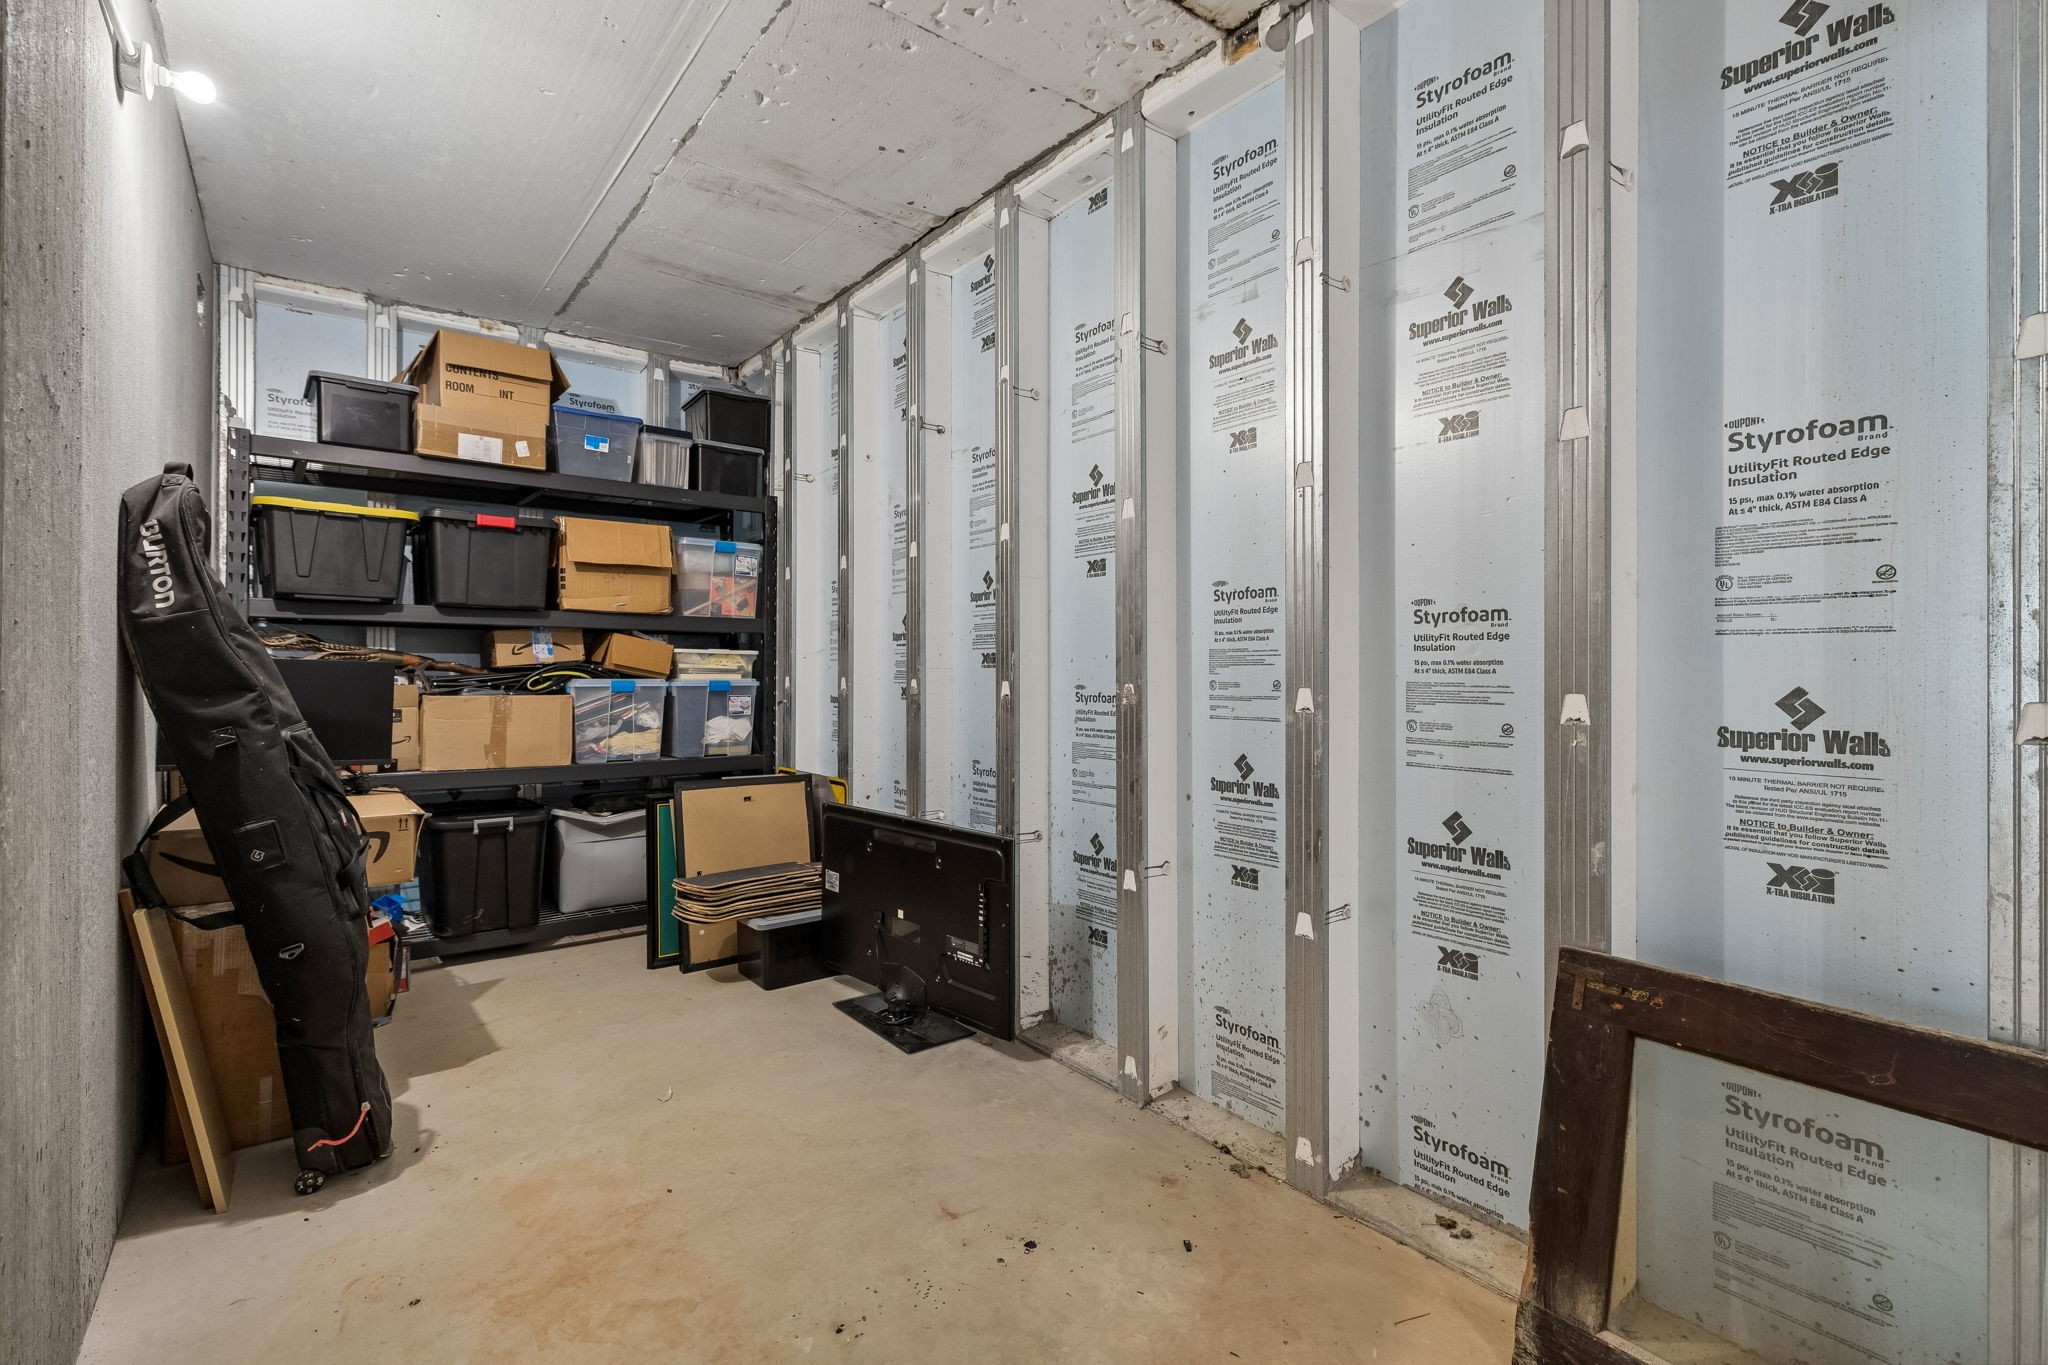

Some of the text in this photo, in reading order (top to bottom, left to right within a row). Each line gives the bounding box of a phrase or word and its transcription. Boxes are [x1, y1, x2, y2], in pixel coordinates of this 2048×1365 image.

[1720, 4, 1895, 89] Superior Walls
[1744, 37, 1878, 93] www.superiorwalls.com
[1416, 53, 1511, 108] Styrofoam
[1416, 75, 1513, 126] UtilityFit Routed Edge
[1416, 112, 1458, 136] Insulation
[1742, 136, 1778, 158] NOTICE
[1793, 121, 1828, 140] Builder
[1830, 118, 1838, 126] &
[1840, 106, 1878, 123] Owner:
[1213, 139, 1276, 180] Styrofoam
[1769, 187, 1839, 215] X-TRA INSULATION
[1409, 295, 1512, 340] Superior Walls
[1423, 320, 1503, 346] www.superiorwalls.com
[1209, 334, 1278, 369] Superior Walls
[445, 364, 500, 381] CONTENTS
[445, 380, 514, 401] ROOM INT
[569, 397, 615, 411] Styrofoam
[1728, 415, 1888, 451] Styrofoam
[1728, 446, 1891, 474] UtilityFit Routed Edge
[1728, 471, 1797, 487] Insulation
[1729, 497, 1738, 505] 15
[1777, 491, 1797, 499] 0.1%
[1799, 489, 1825, 497] water
[1827, 482, 1880, 494] absorption
[1759, 503, 1783, 512] thick,
[1785, 500, 1811, 509] ASTM
[1813, 498, 1831, 507] E84
[1833, 496, 1858, 505] Class
[1859, 494, 1867, 502] A
[139, 518, 175, 609] BURTON
[1214, 587, 1277, 602] Styrofoam
[1413, 608, 1508, 626] Styrofoam
[1413, 643, 1456, 652] Insulation
[1414, 632, 1510, 643] UtilityFit Routed Edge
[1717, 726, 1891, 757] Superior Walls
[972, 766, 997, 778] Styrofo
[1740, 756, 1874, 770] www.superiorwalls.com
[1210, 777, 1280, 799] Superior Walls
[1763, 778, 1796, 786] THERMAL
[1847, 785, 1885, 793] REQUIRE
[1739, 818, 1874, 840] NOTICE to Builder & Owner:
[1740, 826, 1772, 835] essential
[1805, 833, 1828, 841] follow
[1829, 836, 1863, 845] Superior
[1407, 837, 1511, 870] Superior Walls
[1725, 831, 1759, 840] published
[1760, 835, 1798, 844] guidelines
[1811, 842, 1860, 852] construction
[1421, 862, 1501, 880] www.superiorwalls.com
[1766, 887, 1835, 904] X-TRA INSULATION
[1420, 910, 1443, 919] NOTICE
[1451, 916, 1472, 926] Builder
[1479, 923, 1502, 933] Owner:
[1725, 1096, 1884, 1160] Styrofoam
[1414, 1126, 1509, 1177] Styrofoam
[1725, 1139, 1794, 1169] Insulation
[1725, 1126, 1887, 1184] UtilityFit Routed Edge
[1414, 1159, 1456, 1184] Insulation
[1414, 1149, 1510, 1197] UtilityFit Routed Edge
